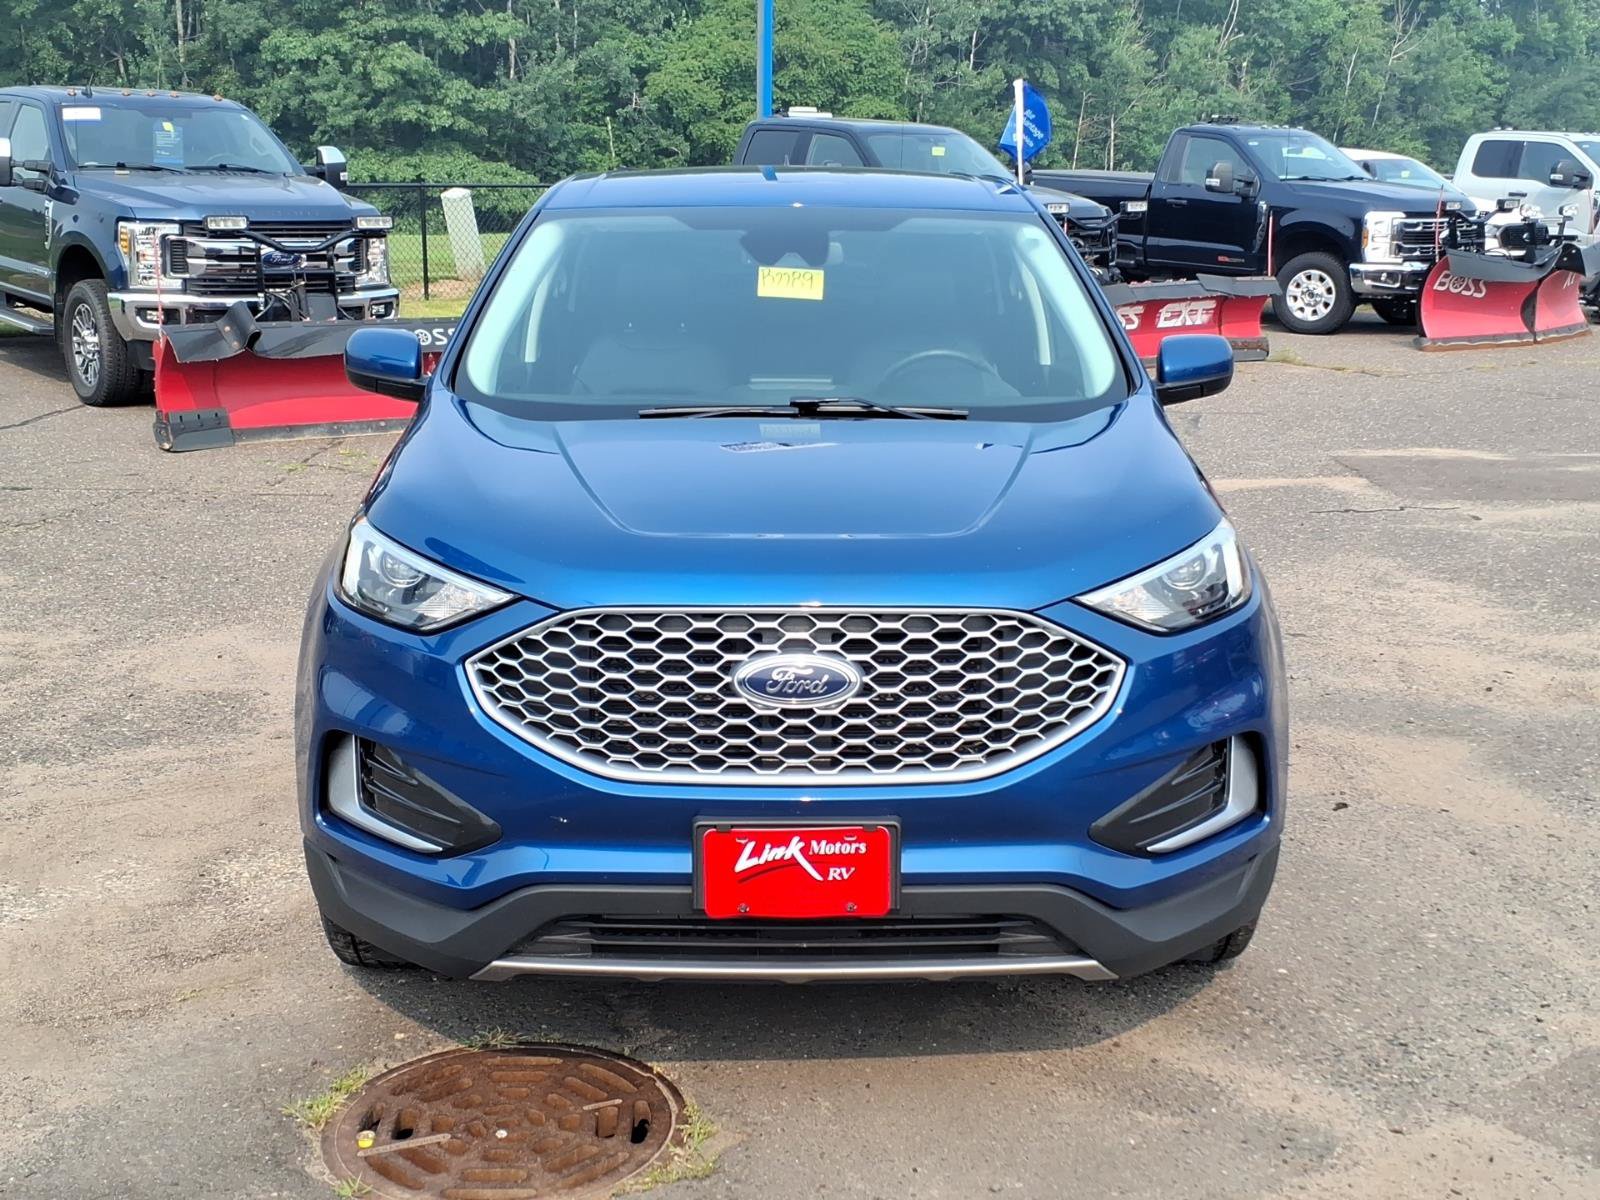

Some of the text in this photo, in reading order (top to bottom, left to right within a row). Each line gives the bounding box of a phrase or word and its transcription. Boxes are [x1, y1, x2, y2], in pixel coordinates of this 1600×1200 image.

[1433, 270, 1487, 298] BOSS
[1156, 300, 1217, 328] EXT
[766, 666, 831, 694] Ford
[734, 835, 868, 882] Link Motors
[827, 866, 856, 882] RV
